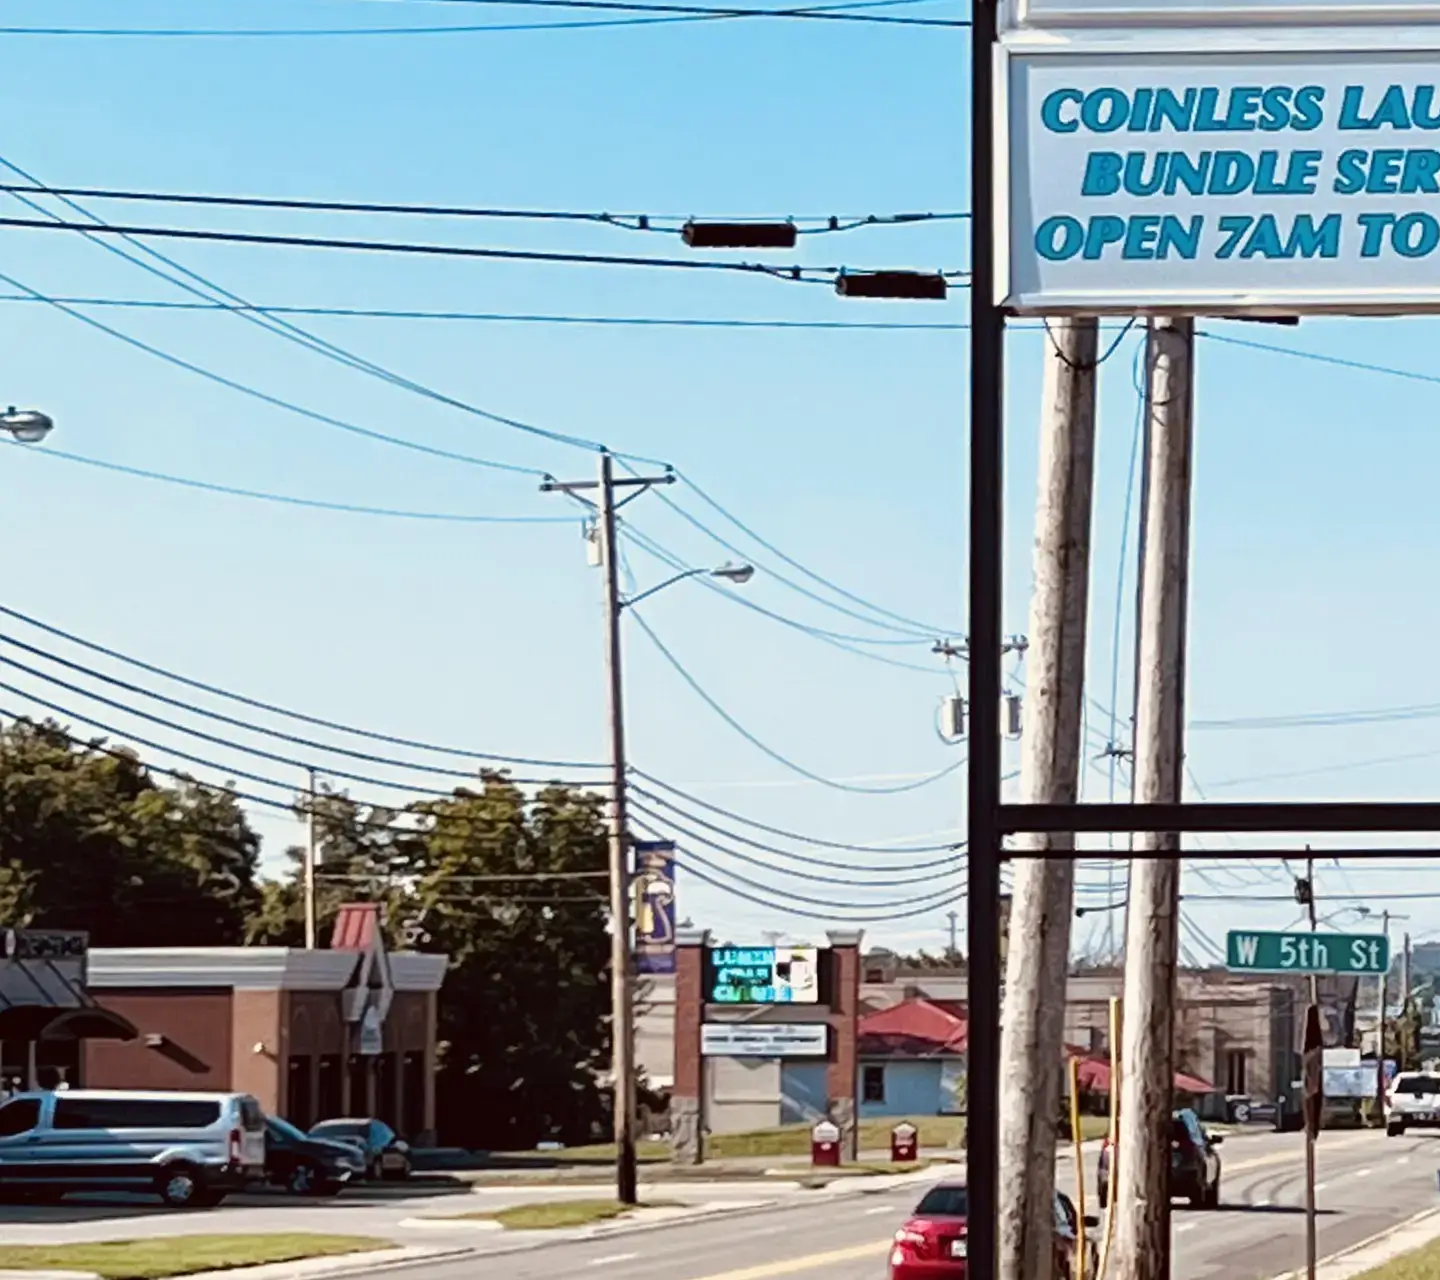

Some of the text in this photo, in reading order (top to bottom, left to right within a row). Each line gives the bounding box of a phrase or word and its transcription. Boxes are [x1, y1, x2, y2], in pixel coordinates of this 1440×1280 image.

[1041, 86, 1325, 133] COINLESS
[1081, 150, 1323, 196] BUNDLE
[1035, 215, 1204, 261] OPEN
[1215, 214, 1342, 260] 7AM
[1358, 212, 1440, 258] TO
[1235, 934, 1381, 970] W 5th St
